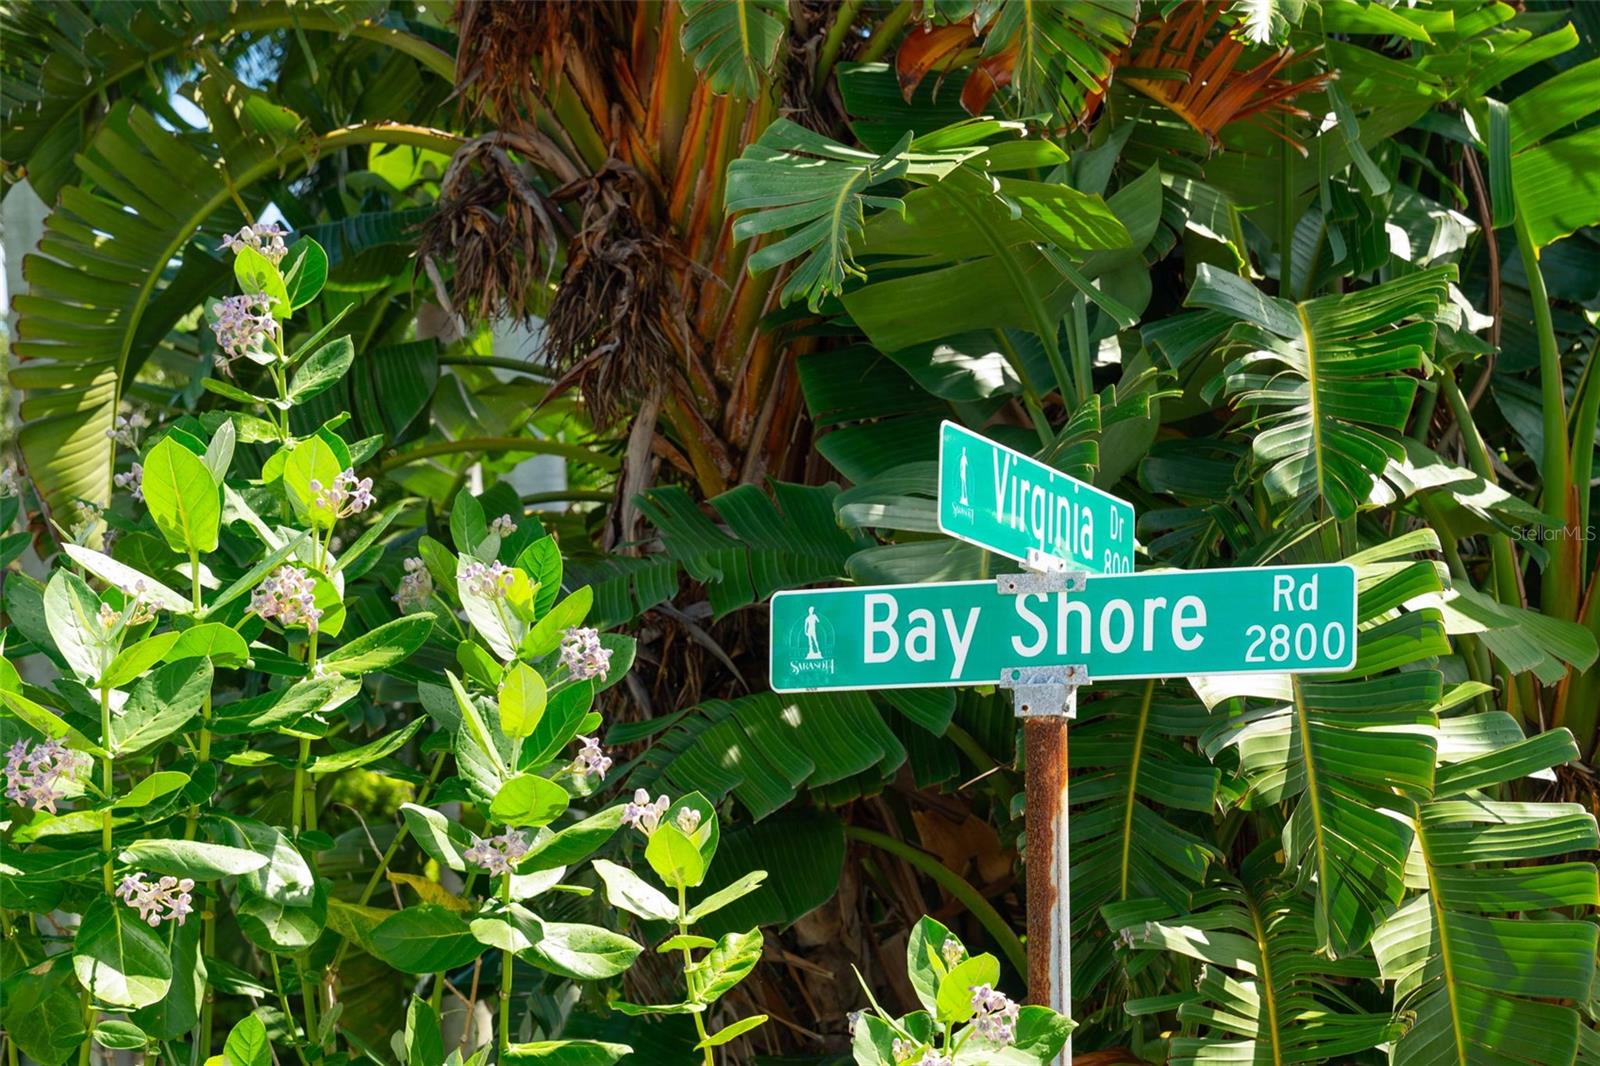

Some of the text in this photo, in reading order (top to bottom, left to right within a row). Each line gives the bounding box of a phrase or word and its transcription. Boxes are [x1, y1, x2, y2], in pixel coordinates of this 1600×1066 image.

[993, 447, 1125, 561] Virginia Dr
[864, 573, 1318, 679] Bay Shore Rd
[1245, 622, 1346, 662] 2800
